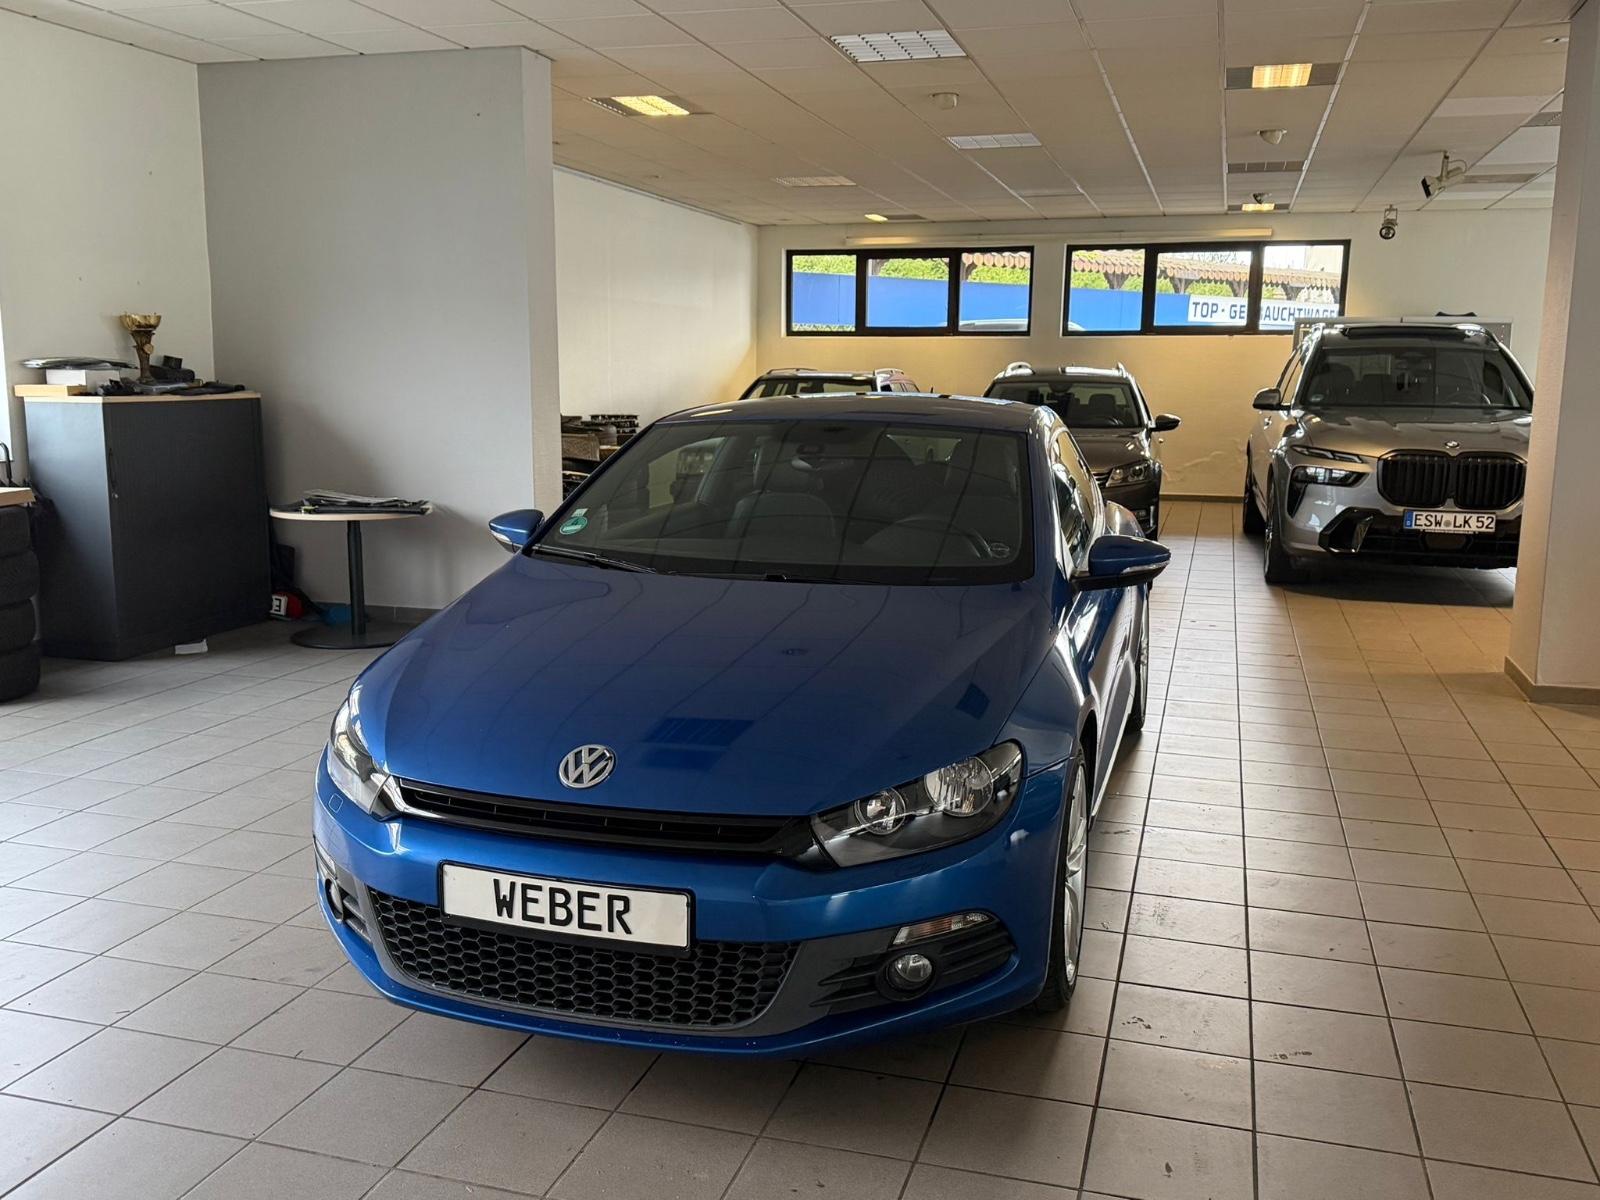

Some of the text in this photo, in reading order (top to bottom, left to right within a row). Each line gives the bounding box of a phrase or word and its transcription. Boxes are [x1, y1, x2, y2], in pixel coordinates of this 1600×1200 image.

[1192, 302, 1219, 318] TOP
[1414, 514, 1495, 530] ESW LK 52
[558, 743, 616, 789] VW
[493, 878, 633, 935] WEBER
